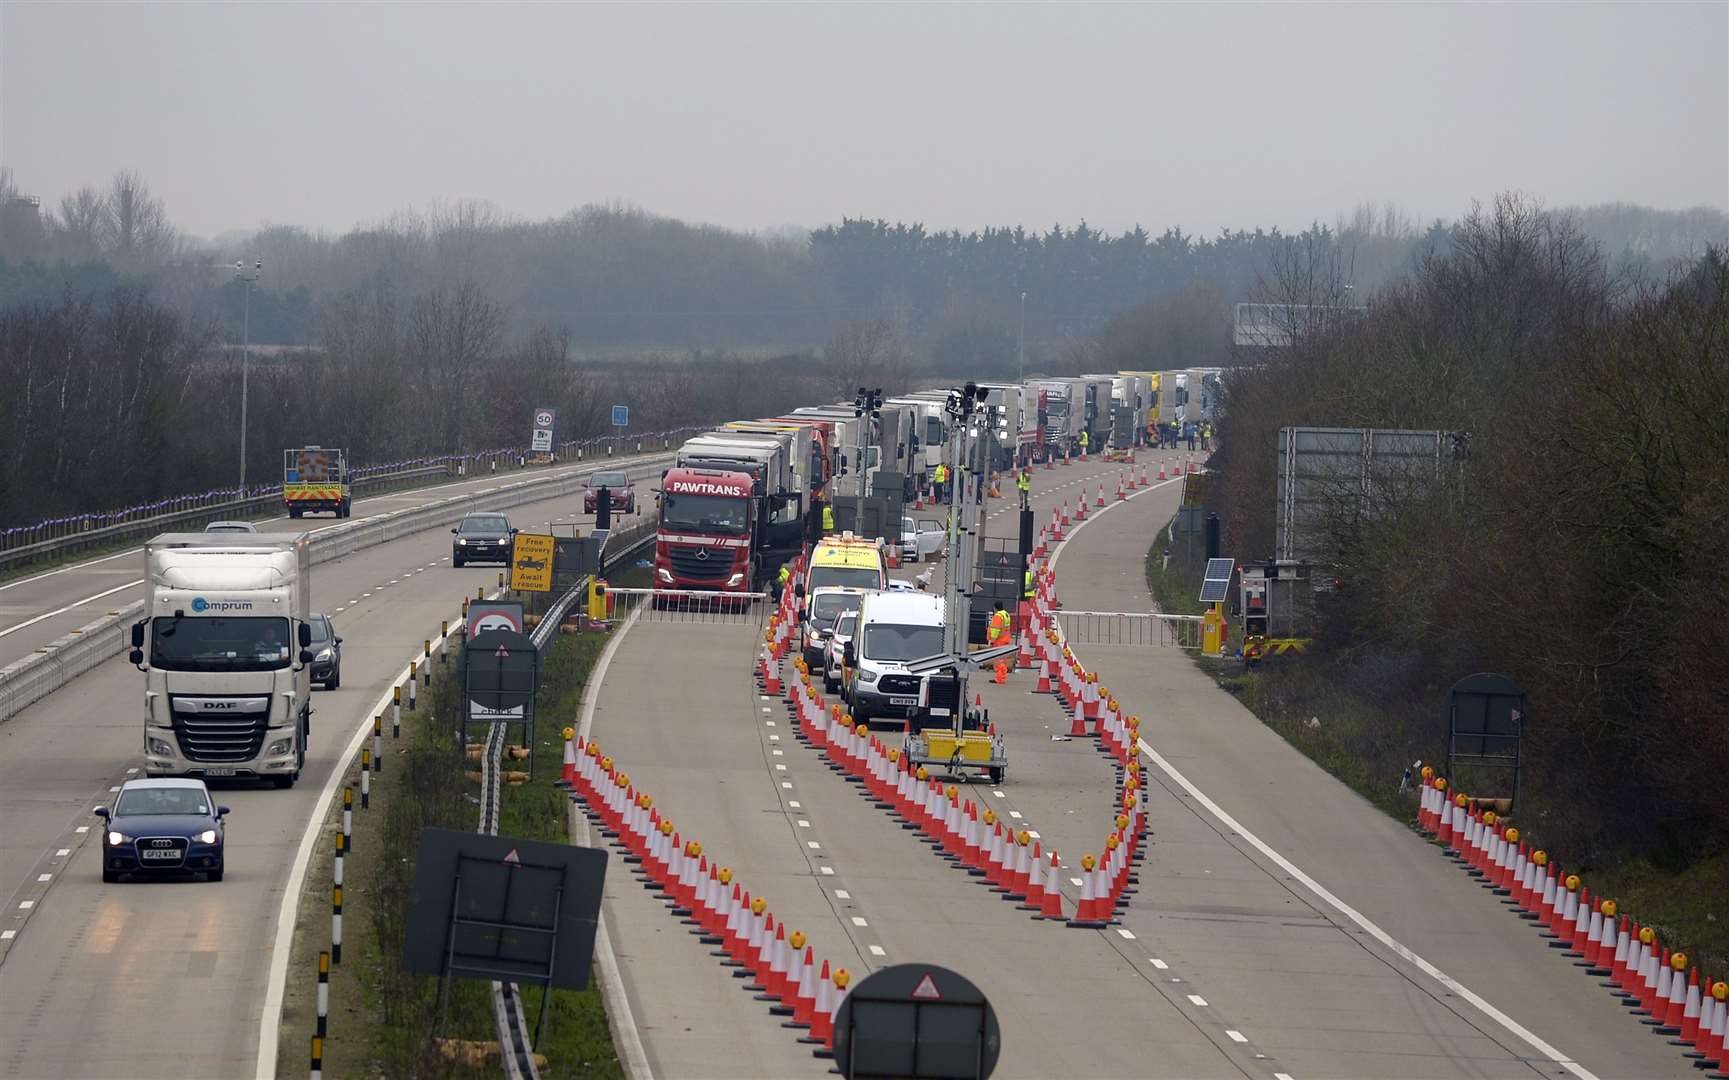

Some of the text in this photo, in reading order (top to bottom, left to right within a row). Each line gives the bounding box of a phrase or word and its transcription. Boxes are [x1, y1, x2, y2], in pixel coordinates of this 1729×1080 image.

[537, 415, 551, 424] 50
[673, 481, 741, 497] PAWTRANS
[526, 537, 544, 545] Free
[516, 546, 549, 554] recovery
[519, 573, 543, 581] Await
[192, 597, 253, 613] Comprum
[146, 850, 162, 858] GF12
